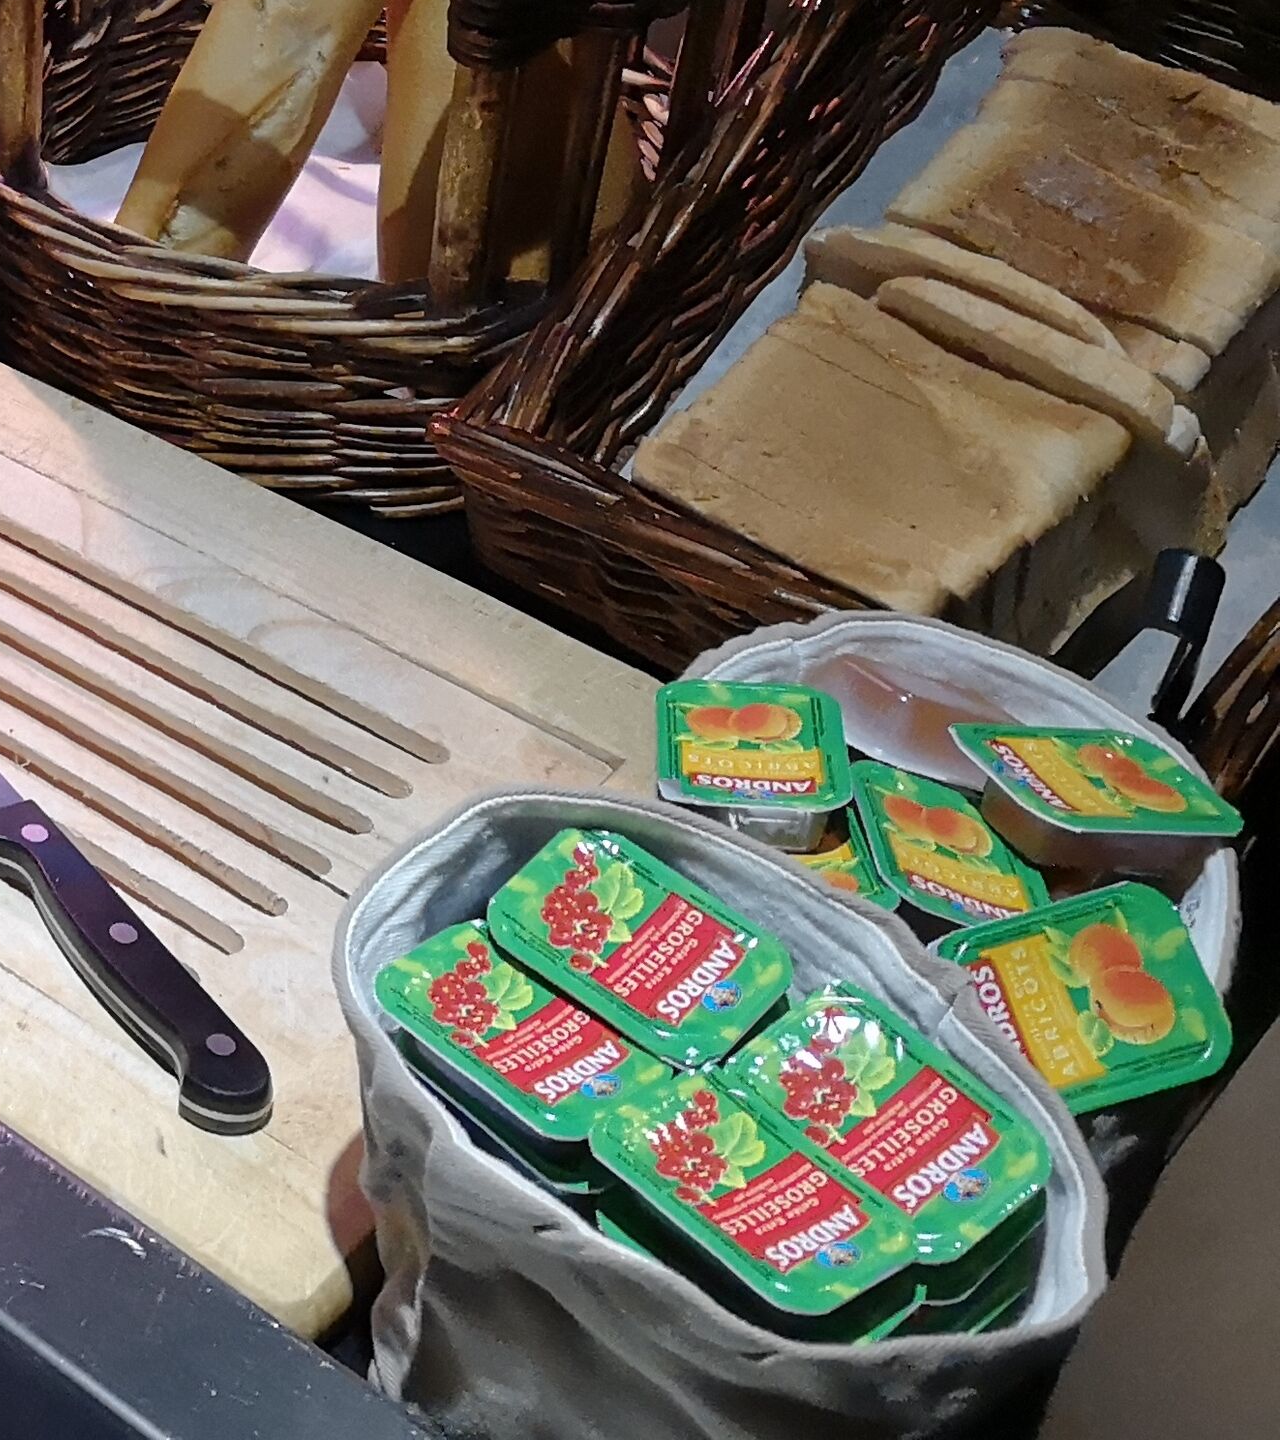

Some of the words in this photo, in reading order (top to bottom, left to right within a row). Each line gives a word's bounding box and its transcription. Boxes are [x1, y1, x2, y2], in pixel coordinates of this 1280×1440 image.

[697, 774, 812, 793] ANDROS
[612, 908, 704, 998] GROSEILLES
[656, 938, 737, 1025] ANDROS
[492, 1010, 592, 1074] GROSEILLES
[533, 1039, 620, 1103] ANDROS
[847, 1085, 961, 1178] GROSEILLES
[891, 1121, 989, 1211] ANDROS
[719, 1169, 830, 1236] GROSEILLES
[764, 1204, 859, 1268] ANDROS
